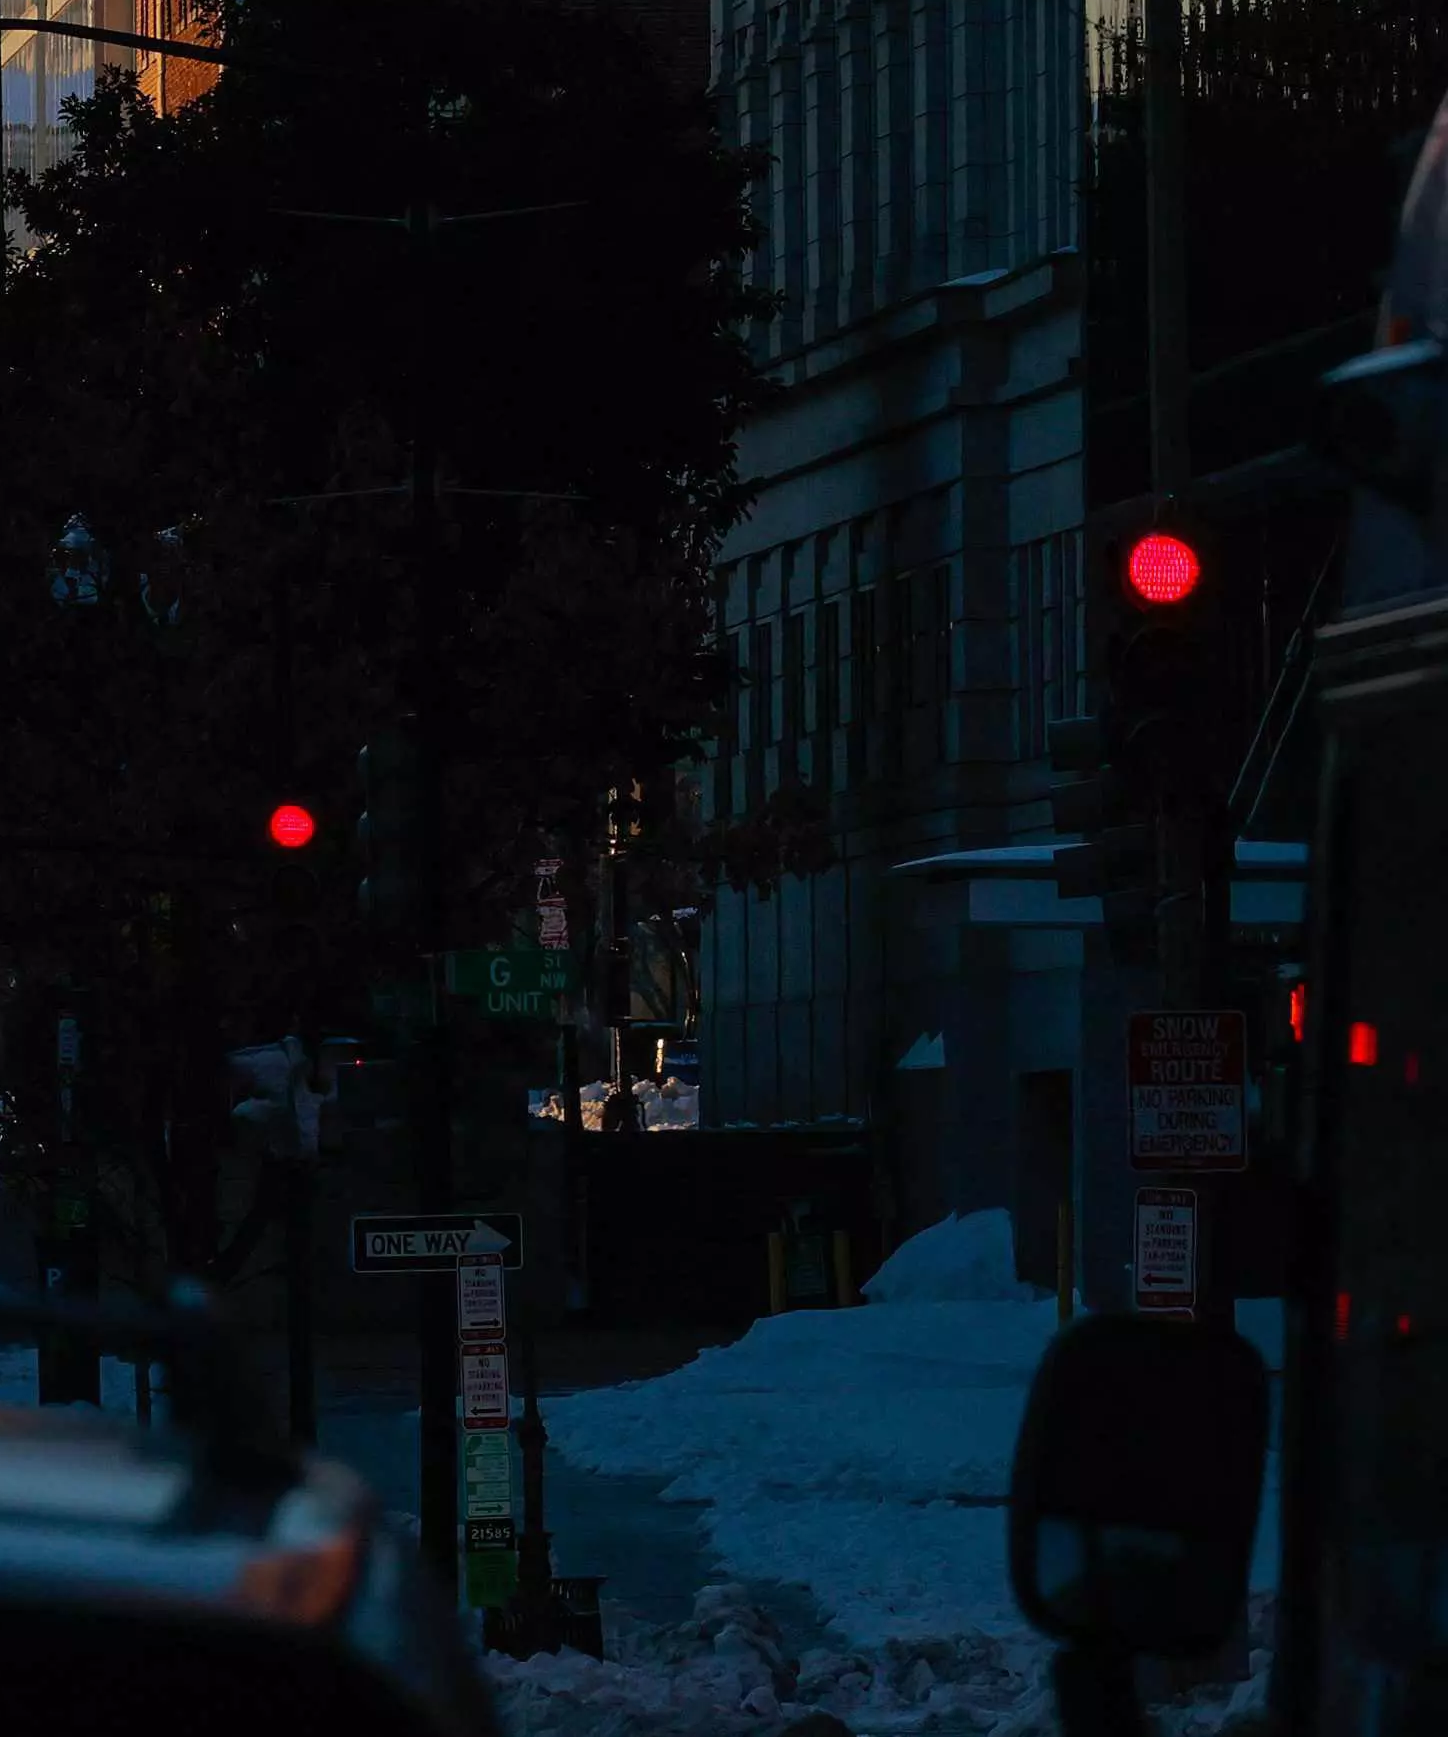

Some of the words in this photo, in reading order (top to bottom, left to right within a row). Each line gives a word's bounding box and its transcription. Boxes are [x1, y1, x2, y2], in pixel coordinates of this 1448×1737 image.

[490, 956, 511, 987] G
[540, 973, 566, 989] NW
[488, 991, 544, 1013] UNIT
[1152, 1016, 1219, 1041] SNOW
[1141, 1042, 1230, 1059] EMERGENCY
[1150, 1059, 1224, 1082] ROUTE
[1137, 1088, 1162, 1109] NO
[1168, 1087, 1235, 1108] PARKING
[1158, 1110, 1218, 1131] DURING
[1139, 1134, 1237, 1153] EMERGENCY
[372, 1235, 416, 1255] ONE
[424, 1233, 471, 1253] WAY
